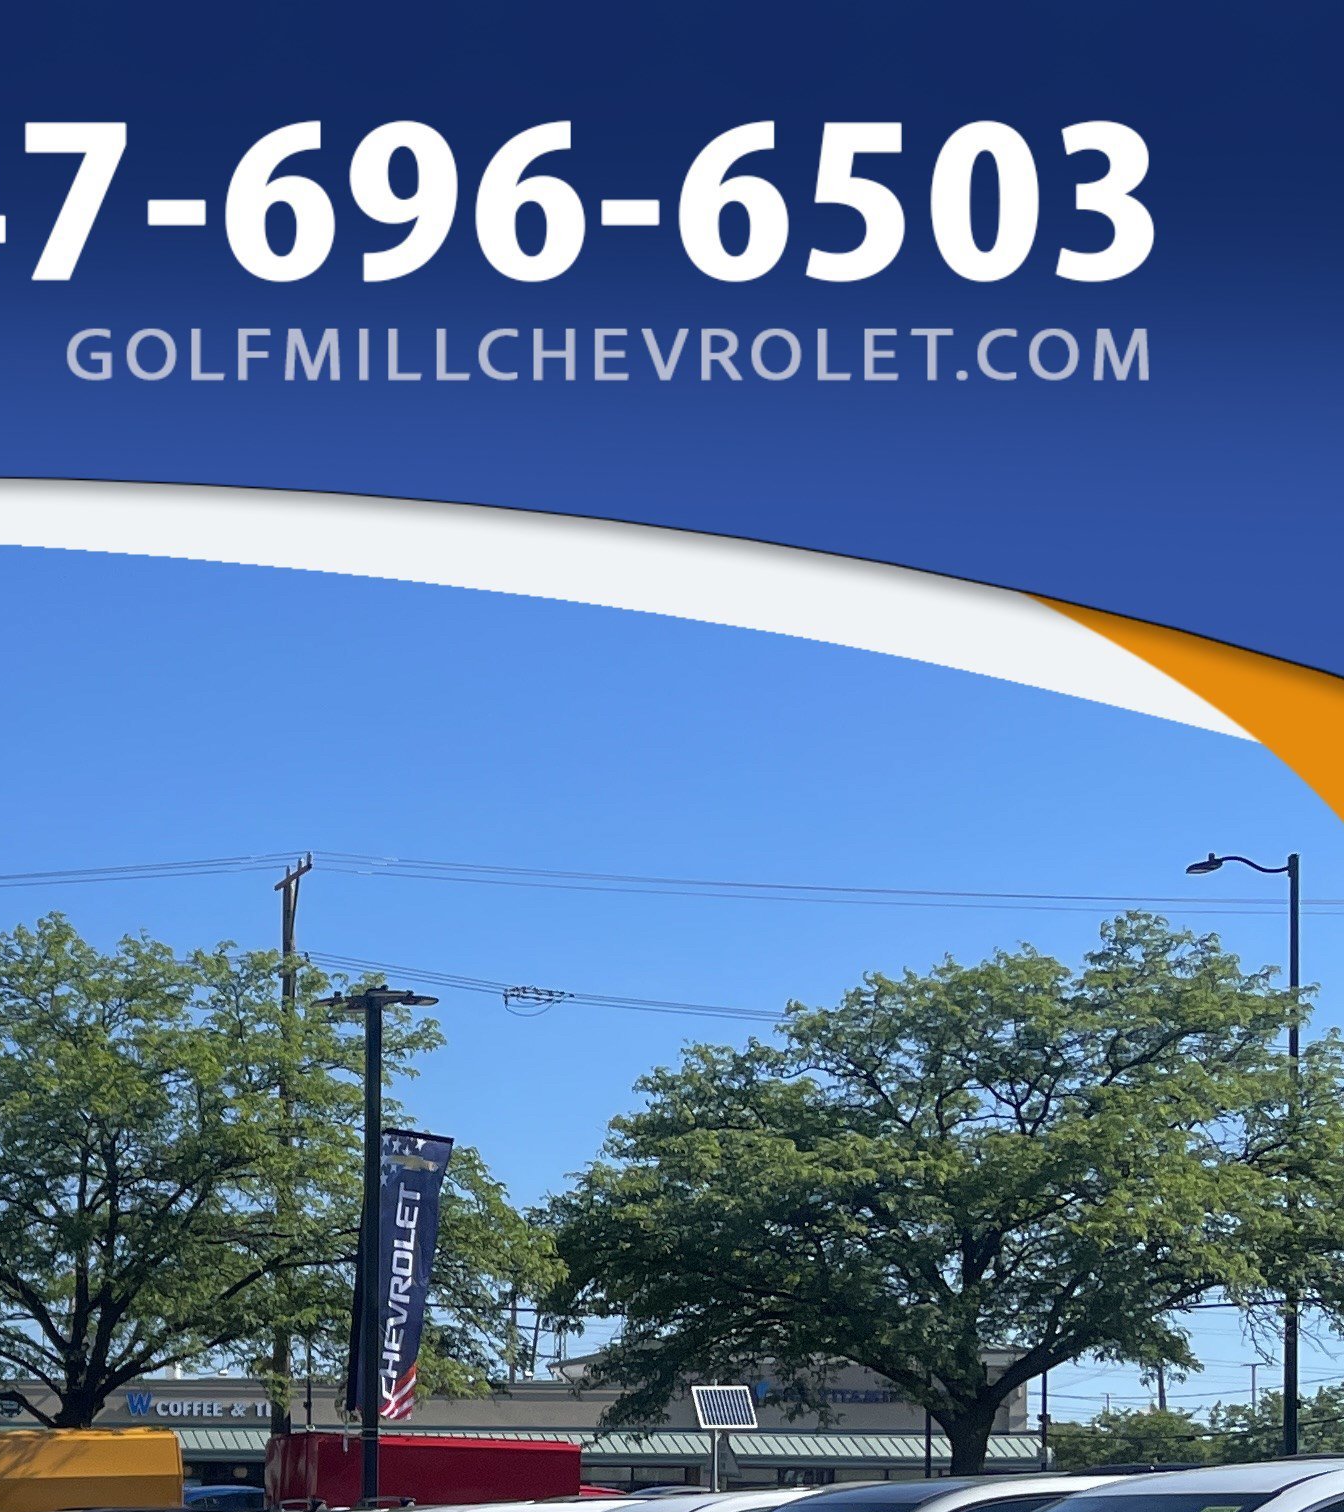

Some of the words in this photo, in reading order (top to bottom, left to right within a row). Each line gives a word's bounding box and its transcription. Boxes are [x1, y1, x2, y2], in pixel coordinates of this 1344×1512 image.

[380, 1181, 421, 1401] CHEVROLET
[125, 1391, 153, 1417] W
[156, 1400, 224, 1418] COFFEE
[230, 1402, 246, 1417] &
